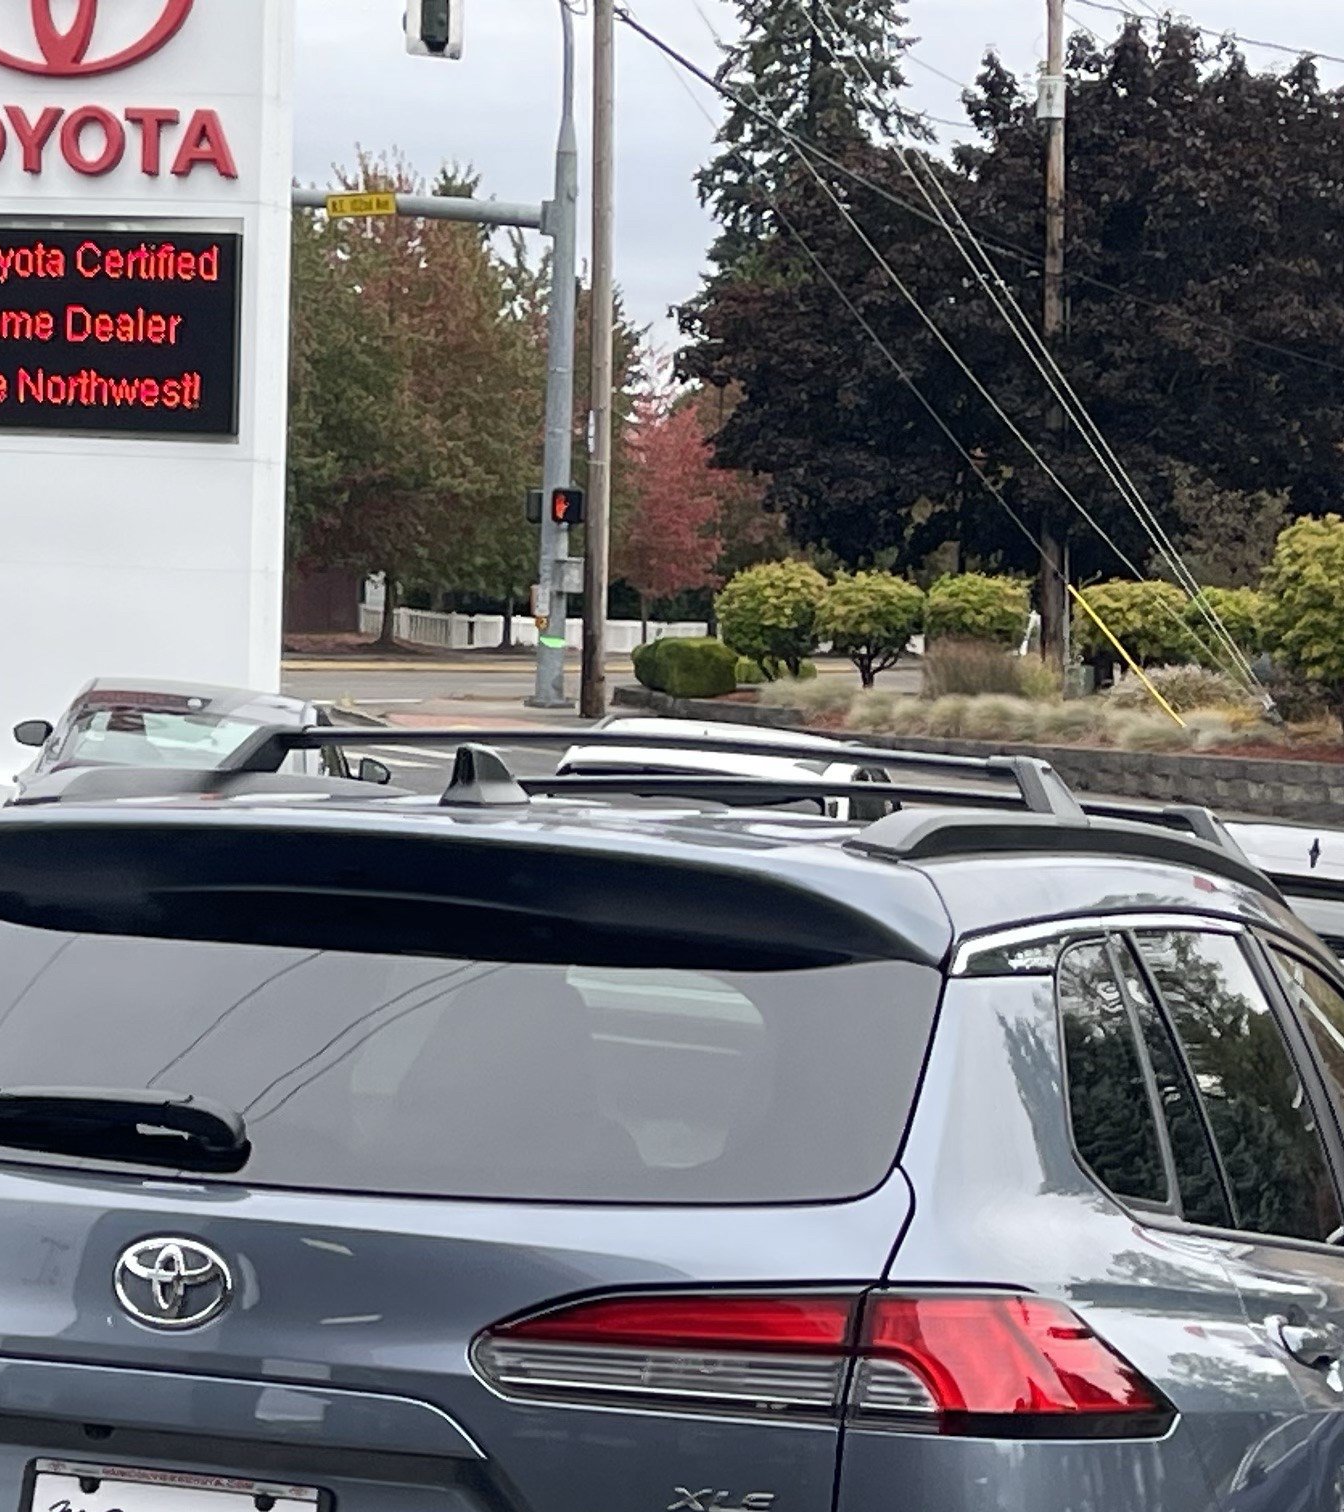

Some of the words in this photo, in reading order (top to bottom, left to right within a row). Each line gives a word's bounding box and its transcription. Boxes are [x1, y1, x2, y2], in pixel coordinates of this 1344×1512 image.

[76, 241, 220, 282] Certified
[66, 306, 183, 346] Dealer
[17, 368, 201, 408] Northwest!
